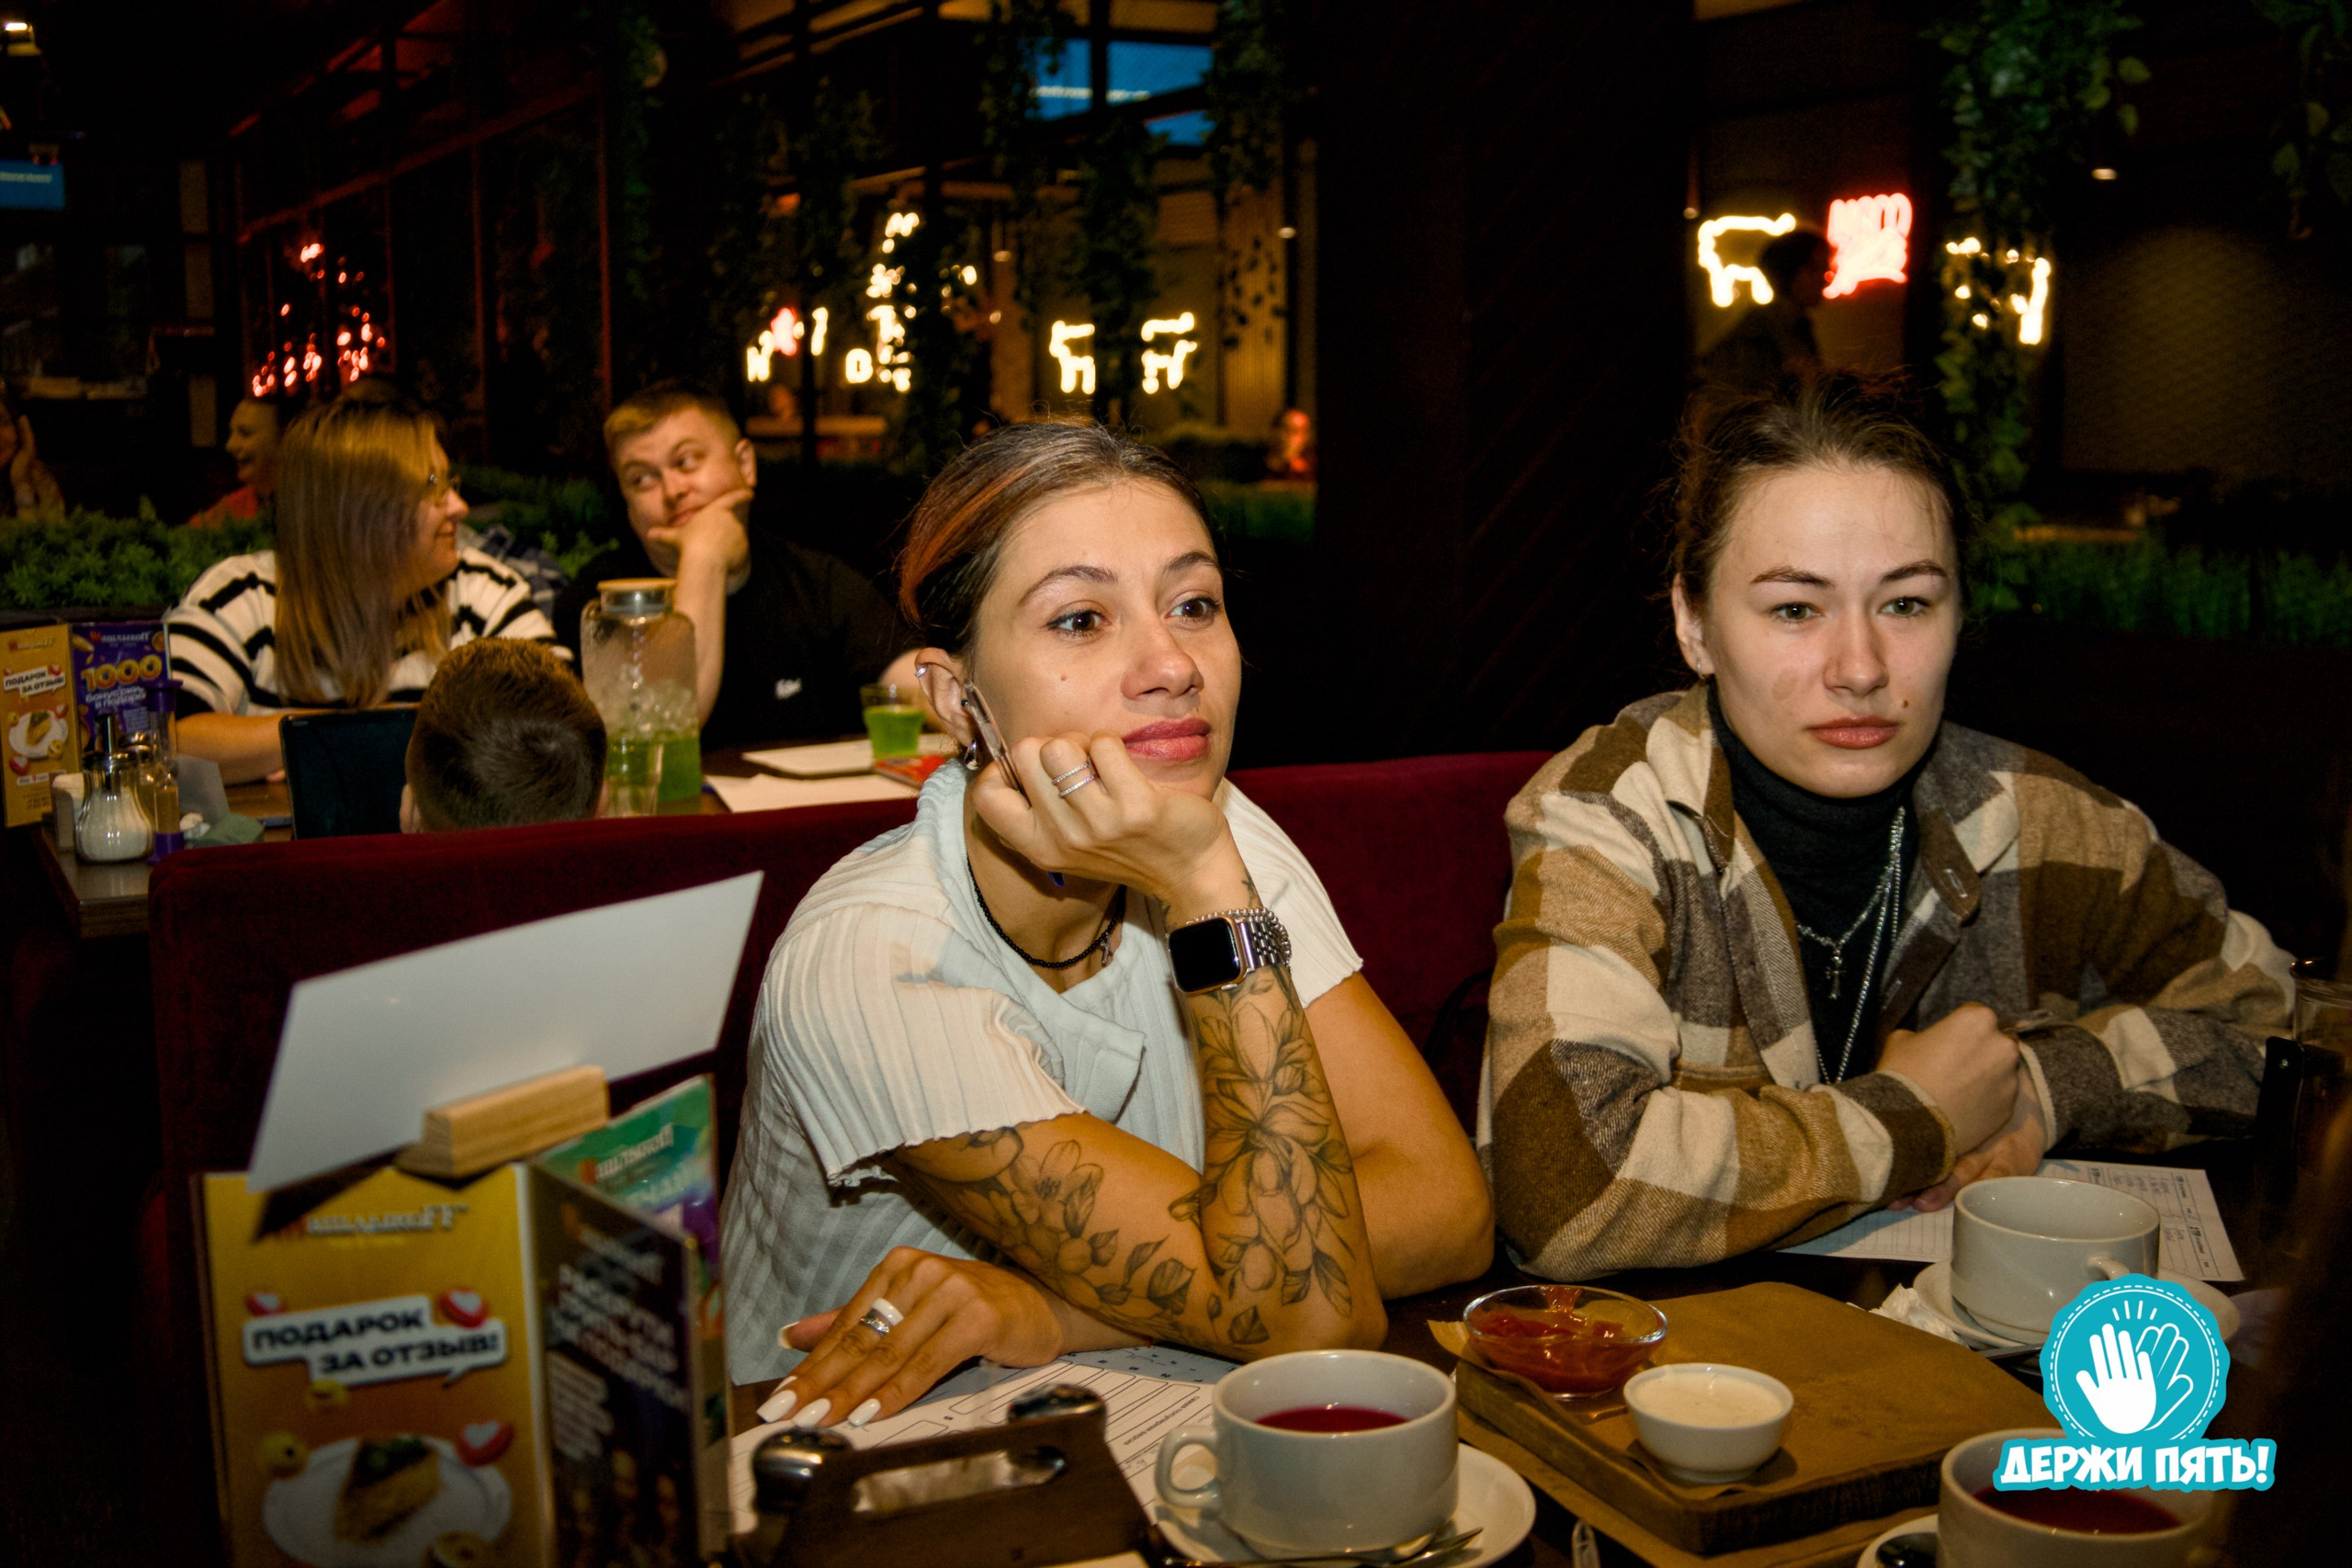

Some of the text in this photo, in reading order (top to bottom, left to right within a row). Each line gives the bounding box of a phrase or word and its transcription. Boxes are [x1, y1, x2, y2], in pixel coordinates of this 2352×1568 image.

[6, 670, 47, 687] ПОДАРОК
[80, 654, 163, 692] 1000
[253, 1307, 425, 1349] ПОДАРОК
[321, 1333, 499, 1373] ЗА ОТЗЫВ!
